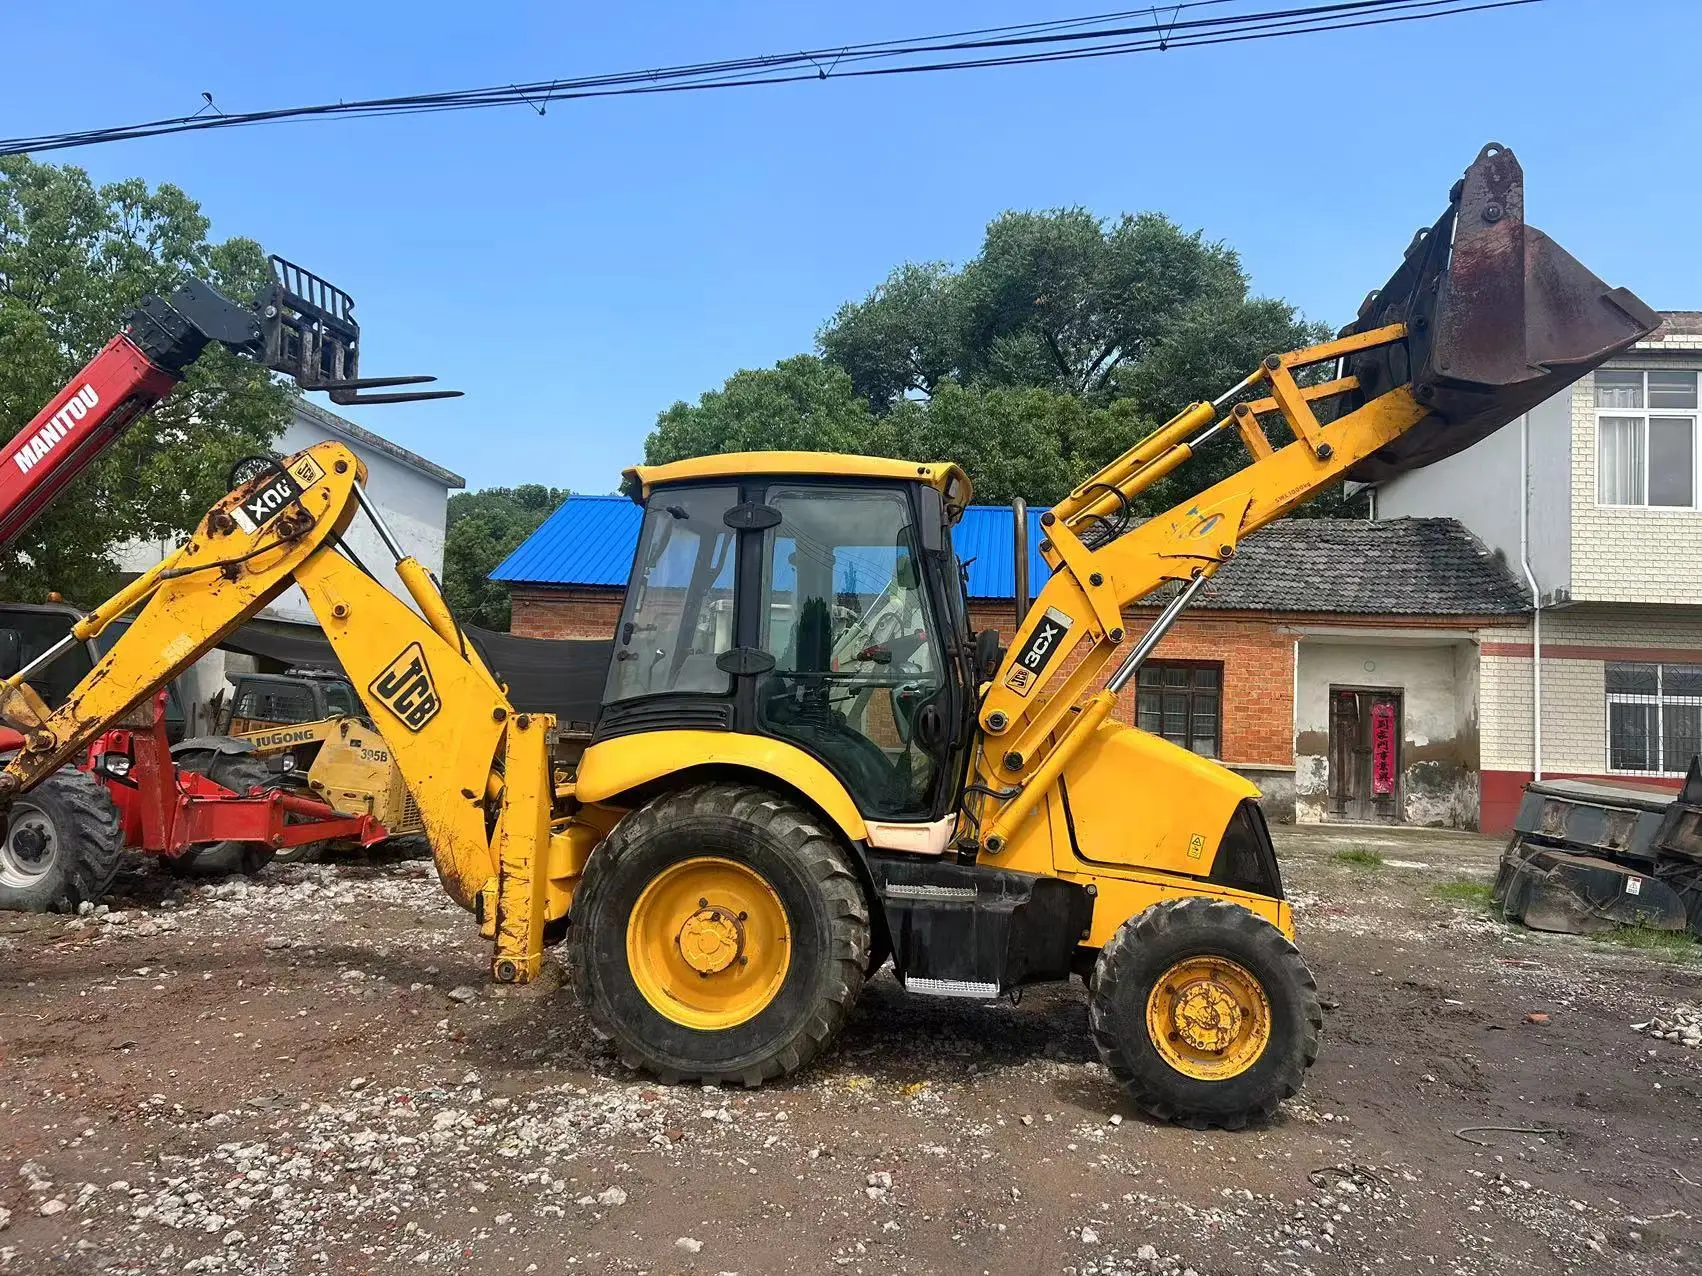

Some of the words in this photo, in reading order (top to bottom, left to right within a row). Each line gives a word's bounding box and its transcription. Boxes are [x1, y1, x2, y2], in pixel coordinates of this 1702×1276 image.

[13, 383, 99, 474] MANITOU
[297, 462, 314, 482] JCB
[1024, 623, 1059, 668] 3CX
[376, 655, 436, 726] JCB
[1010, 670, 1029, 687] JCB
